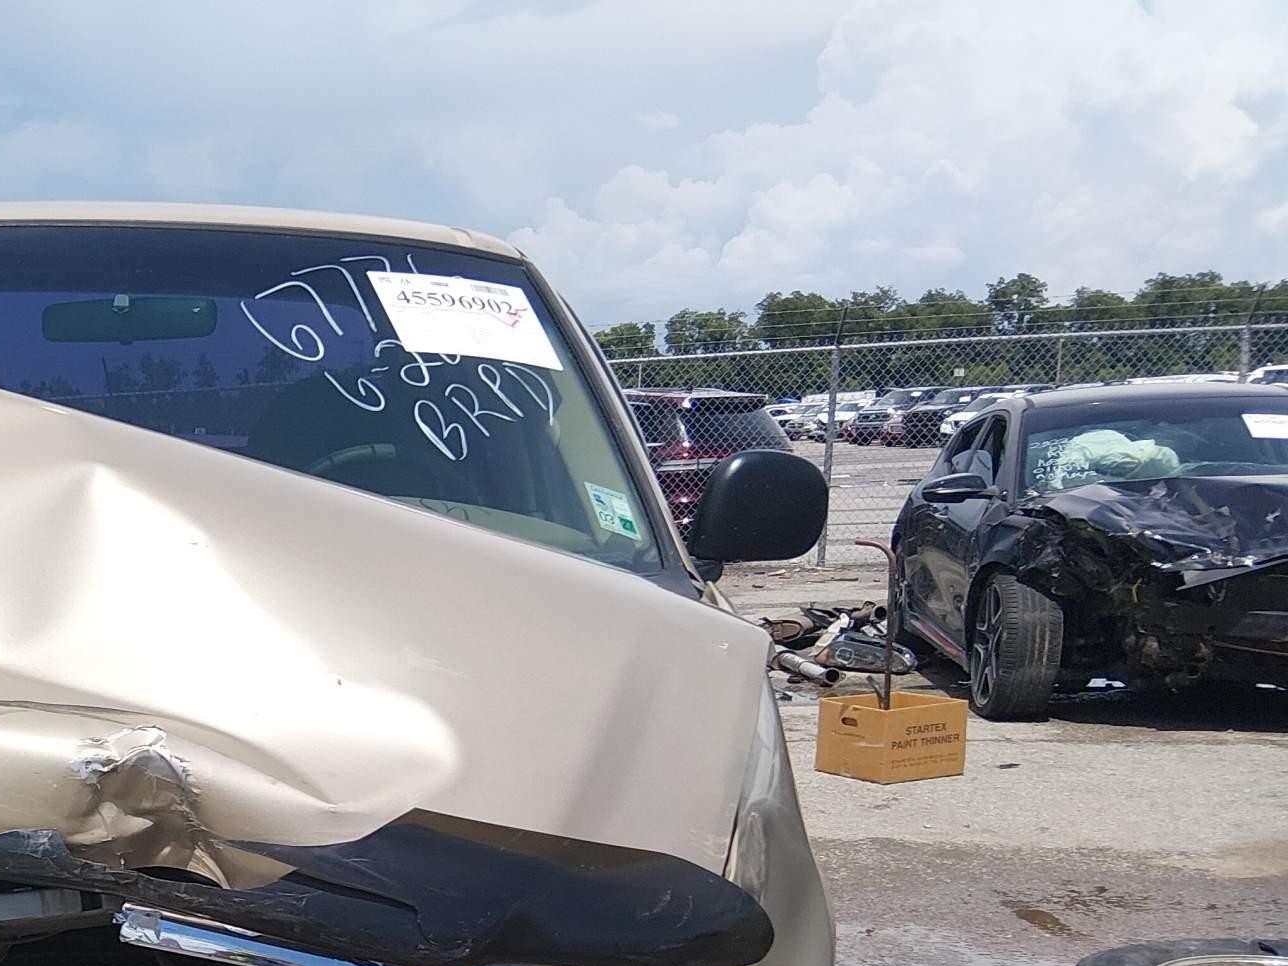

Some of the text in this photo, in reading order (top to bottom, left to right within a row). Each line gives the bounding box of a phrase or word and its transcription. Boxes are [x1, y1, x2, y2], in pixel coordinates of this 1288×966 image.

[396, 289, 516, 317] 45596902
[905, 723, 948, 736] STARTEX
[891, 734, 960, 751] PAINT THINNER
